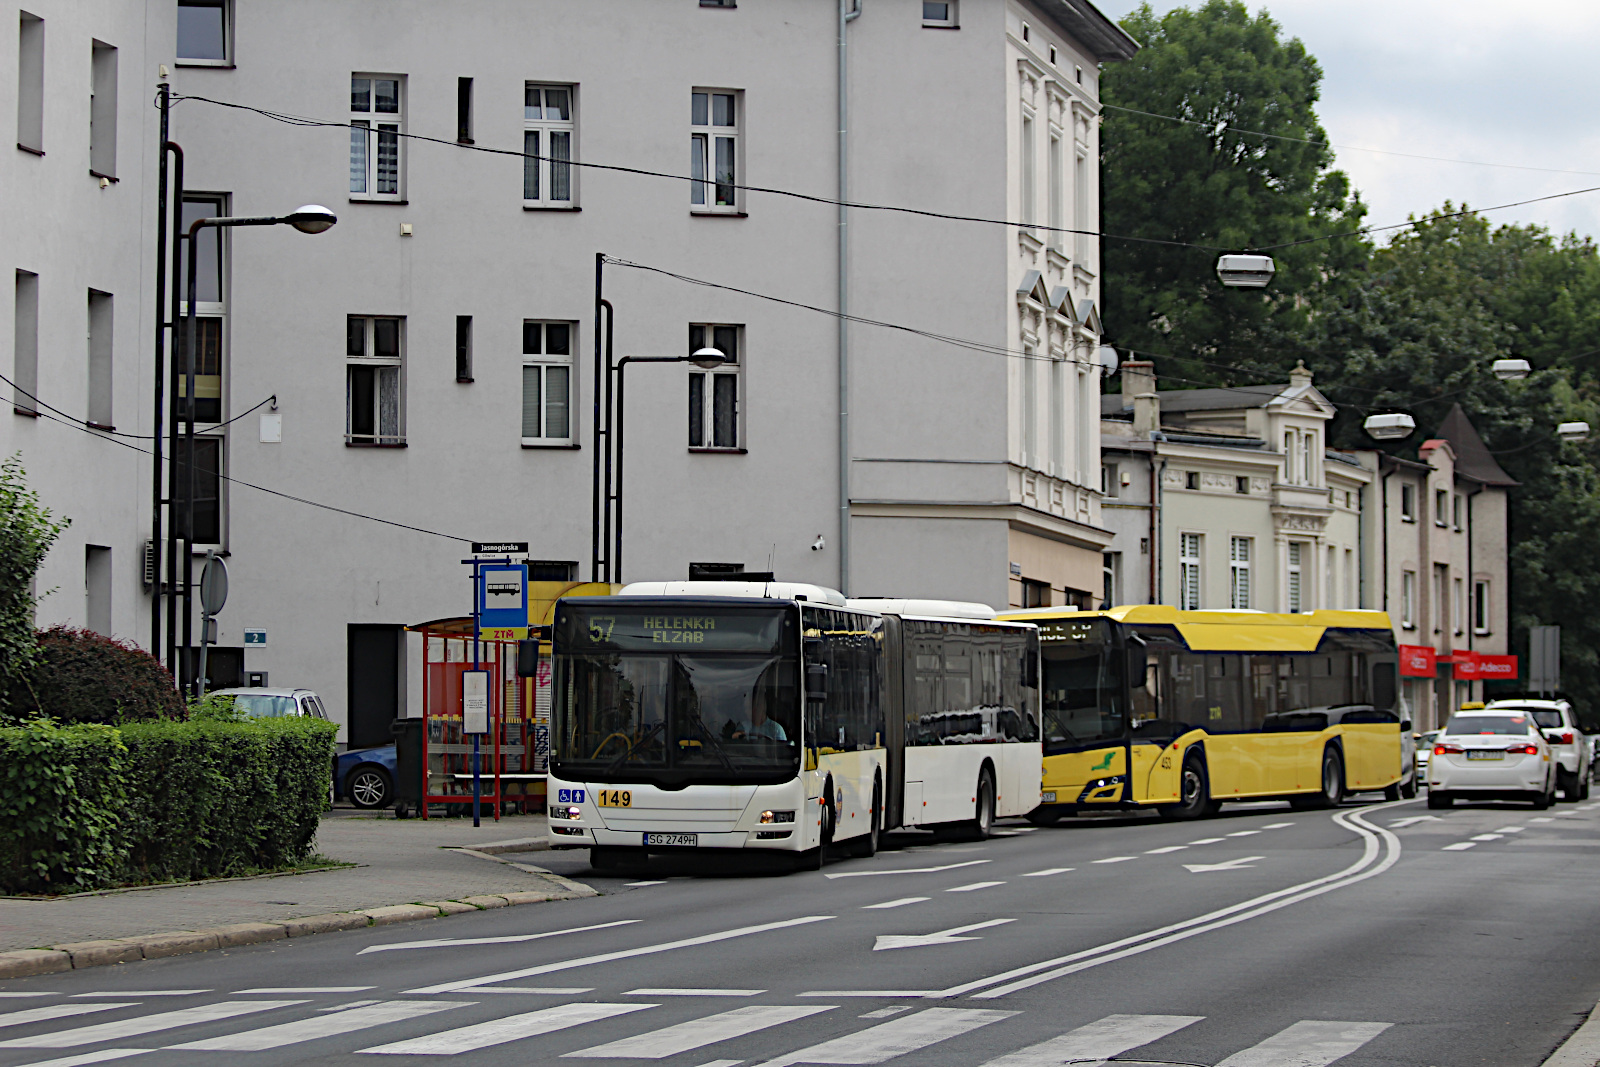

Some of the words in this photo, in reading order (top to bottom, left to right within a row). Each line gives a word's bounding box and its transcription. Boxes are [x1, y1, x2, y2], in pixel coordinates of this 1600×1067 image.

[480, 544, 519, 552] Jasnogórska
[589, 616, 616, 642] 57
[643, 616, 715, 630] HELENKA
[252, 633, 259, 643] 2
[493, 629, 514, 639] ZTM
[652, 630, 704, 643] ELZAB
[1479, 661, 1512, 673] Adecco
[600, 789, 631, 807] 149
[649, 834, 663, 844] SG
[666, 835, 695, 845] 2749H
